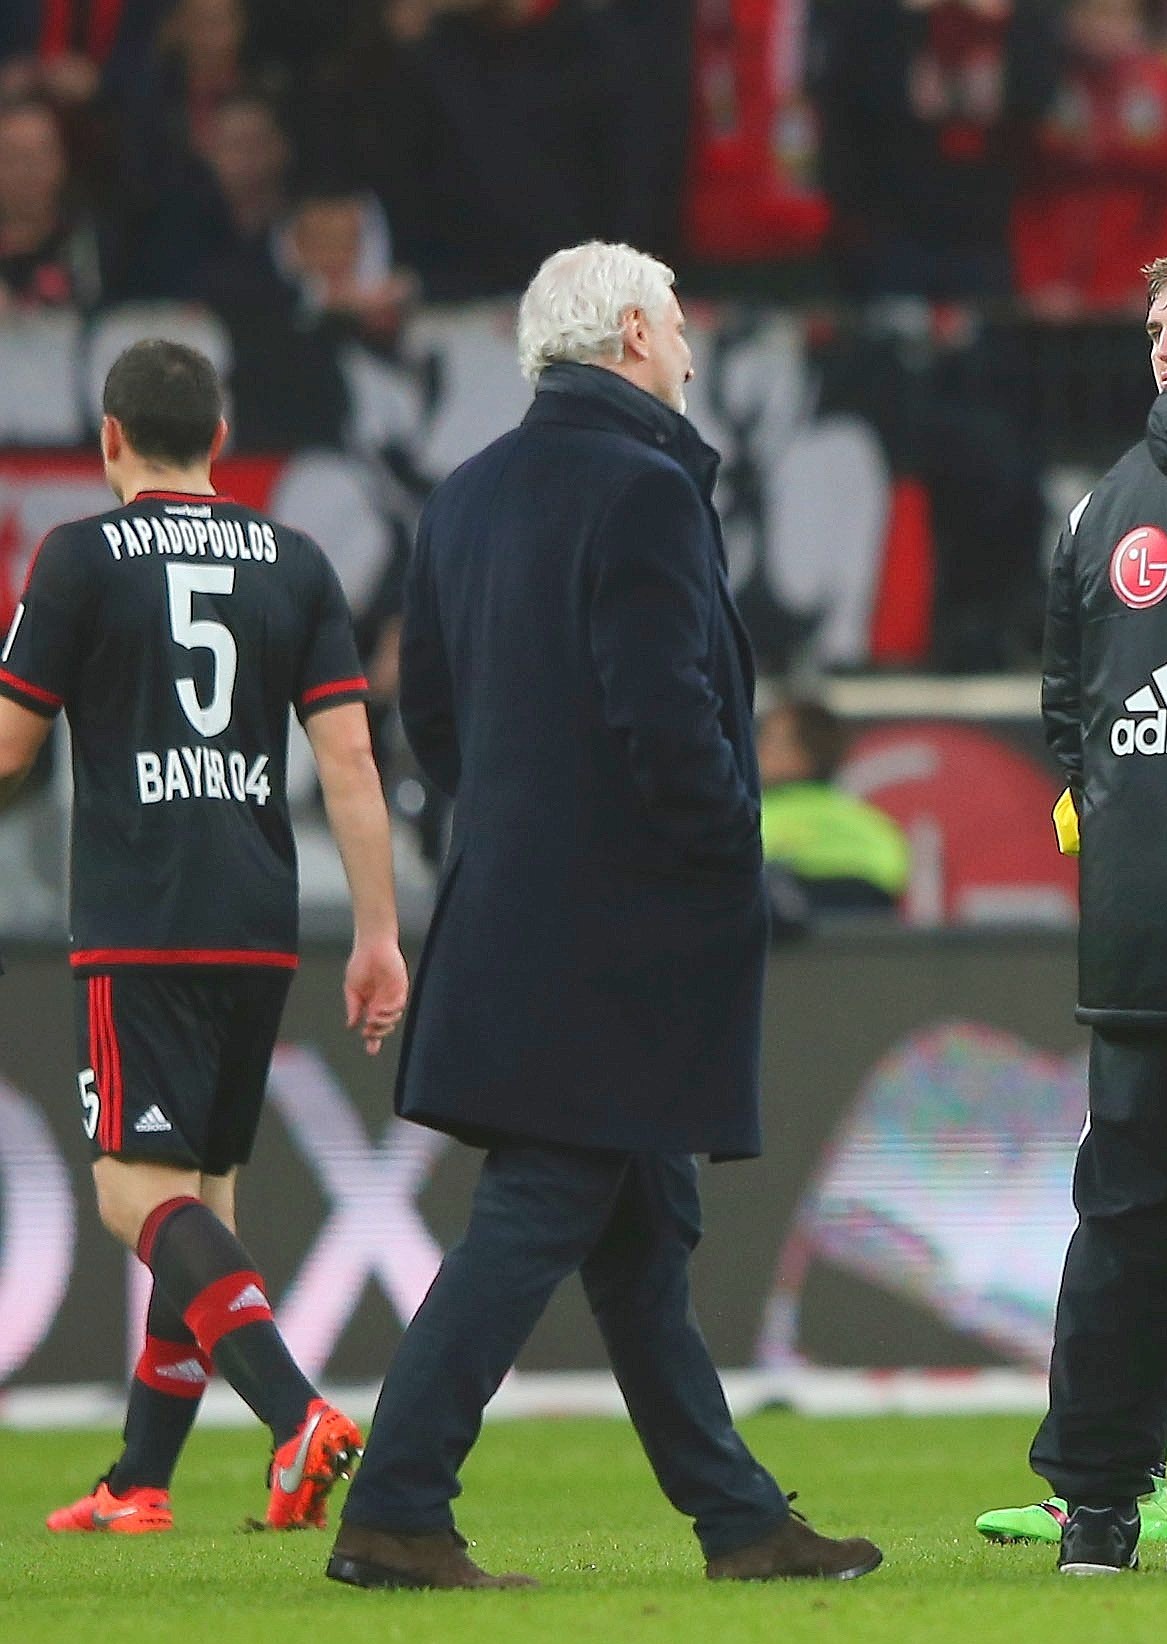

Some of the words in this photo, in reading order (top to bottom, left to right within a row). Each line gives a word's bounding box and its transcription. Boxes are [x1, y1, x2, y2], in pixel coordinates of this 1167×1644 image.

[101, 516, 278, 564] PAPADOPOULOS
[165, 561, 238, 738] 5
[228, 750, 272, 807] 04
[77, 1066, 101, 1140] 5
